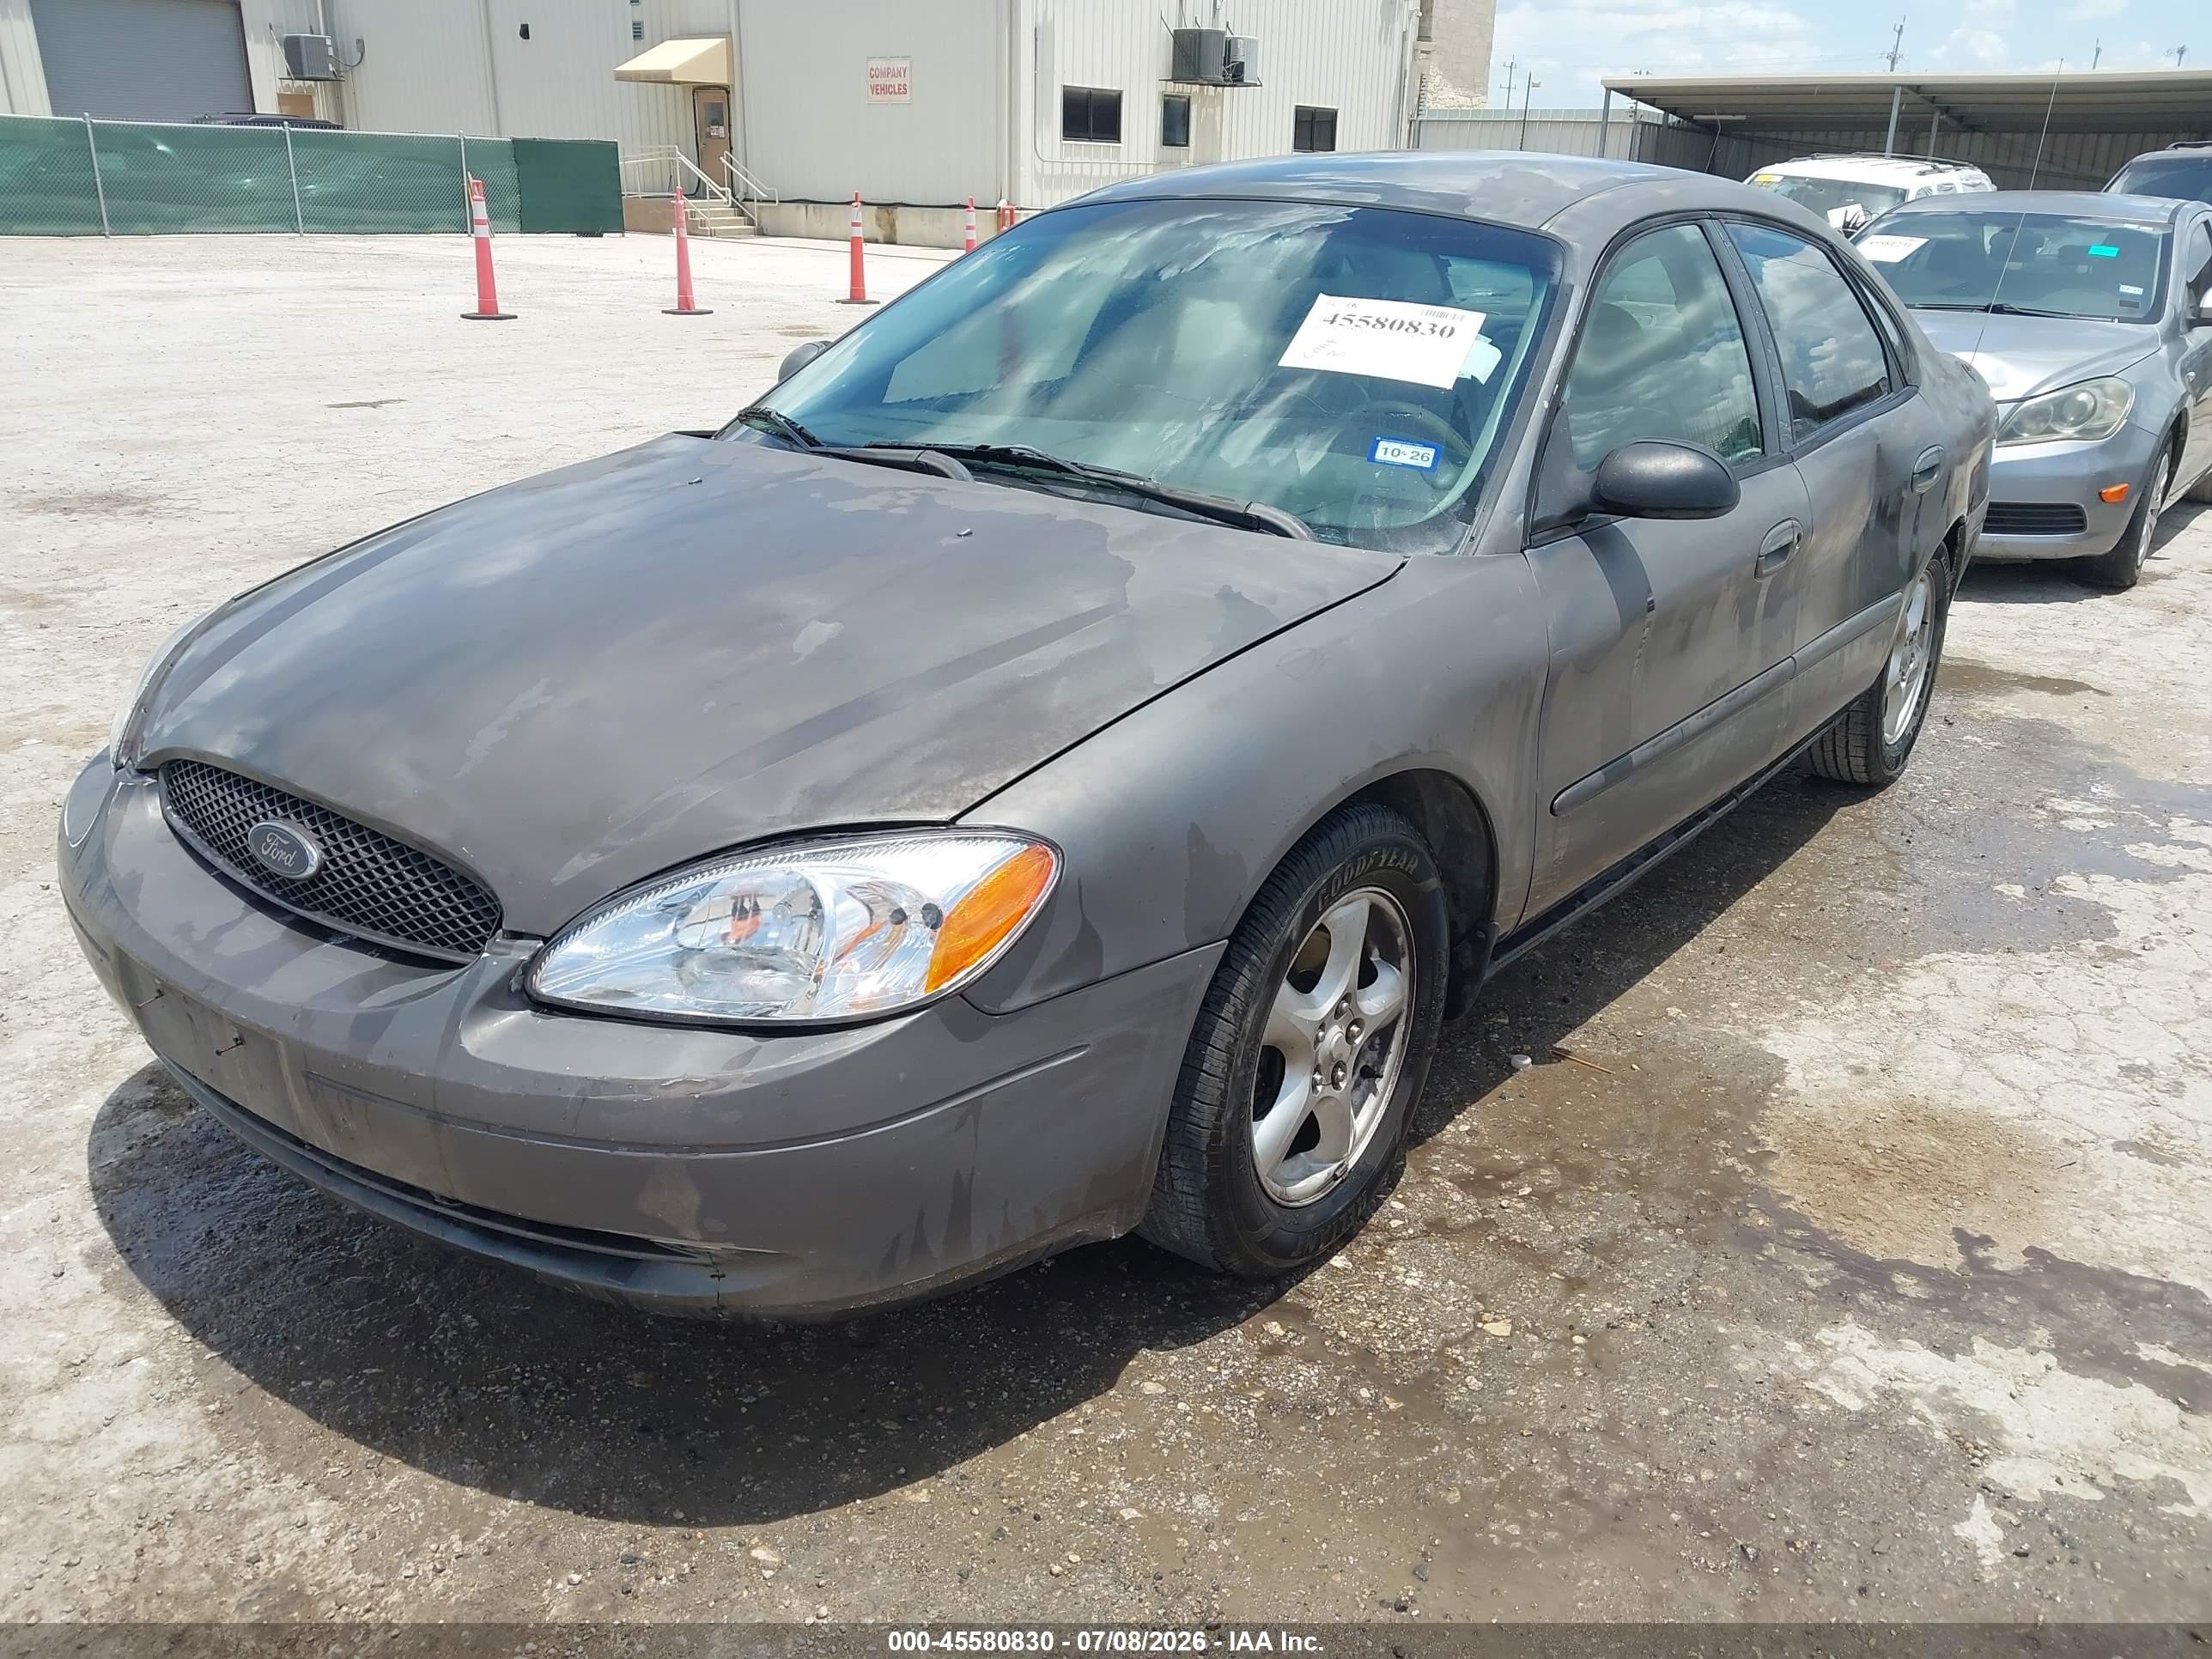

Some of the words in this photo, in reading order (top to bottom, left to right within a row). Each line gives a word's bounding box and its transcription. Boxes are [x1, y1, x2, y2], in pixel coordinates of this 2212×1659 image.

[869, 66, 907, 79] COMPANY
[870, 83, 908, 95] VEHICLES
[1323, 313, 1455, 339] 45580830
[261, 832, 297, 867] Ford
